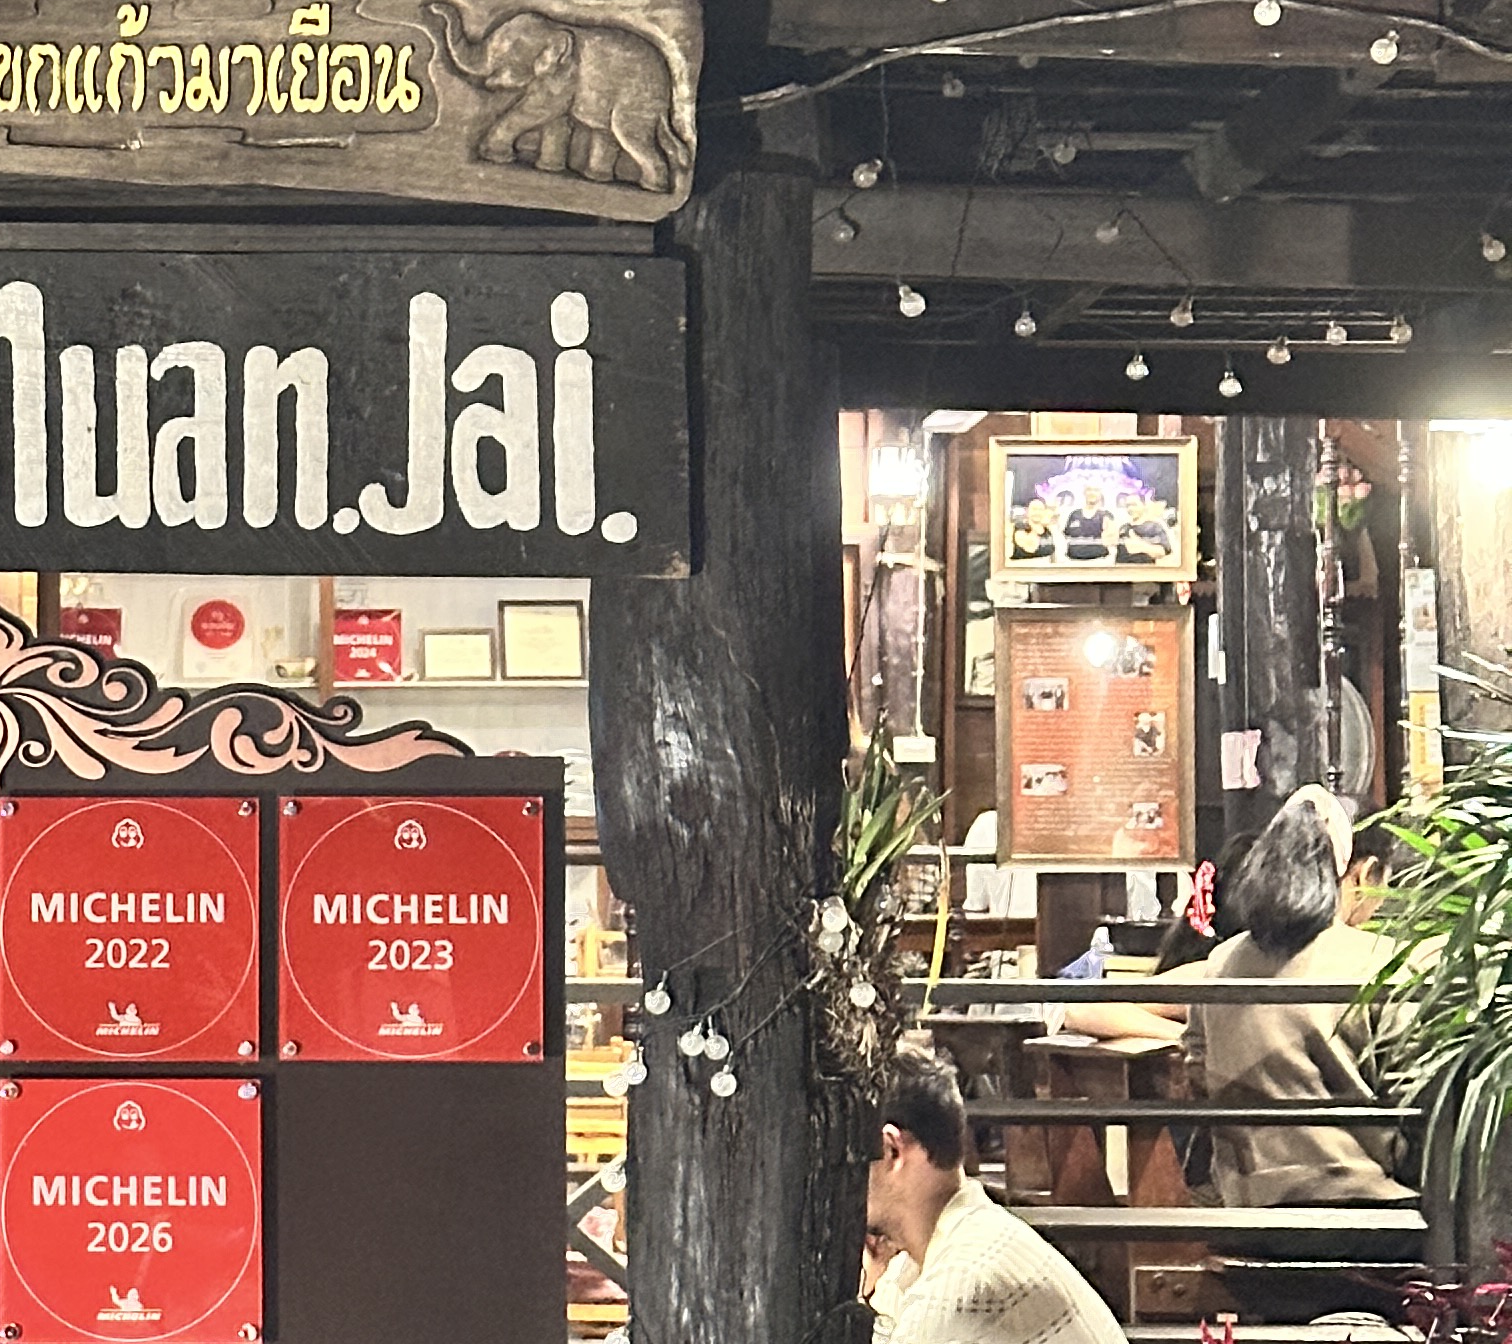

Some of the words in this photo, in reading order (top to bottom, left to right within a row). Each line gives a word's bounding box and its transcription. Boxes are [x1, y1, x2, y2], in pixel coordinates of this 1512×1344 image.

[30, 891, 225, 923] MICHELIN
[312, 893, 508, 925] MICHELIN
[85, 938, 171, 969] 2022
[367, 939, 455, 971] 2023
[32, 1175, 227, 1207] MICHELIN
[87, 1221, 173, 1253] 2026
